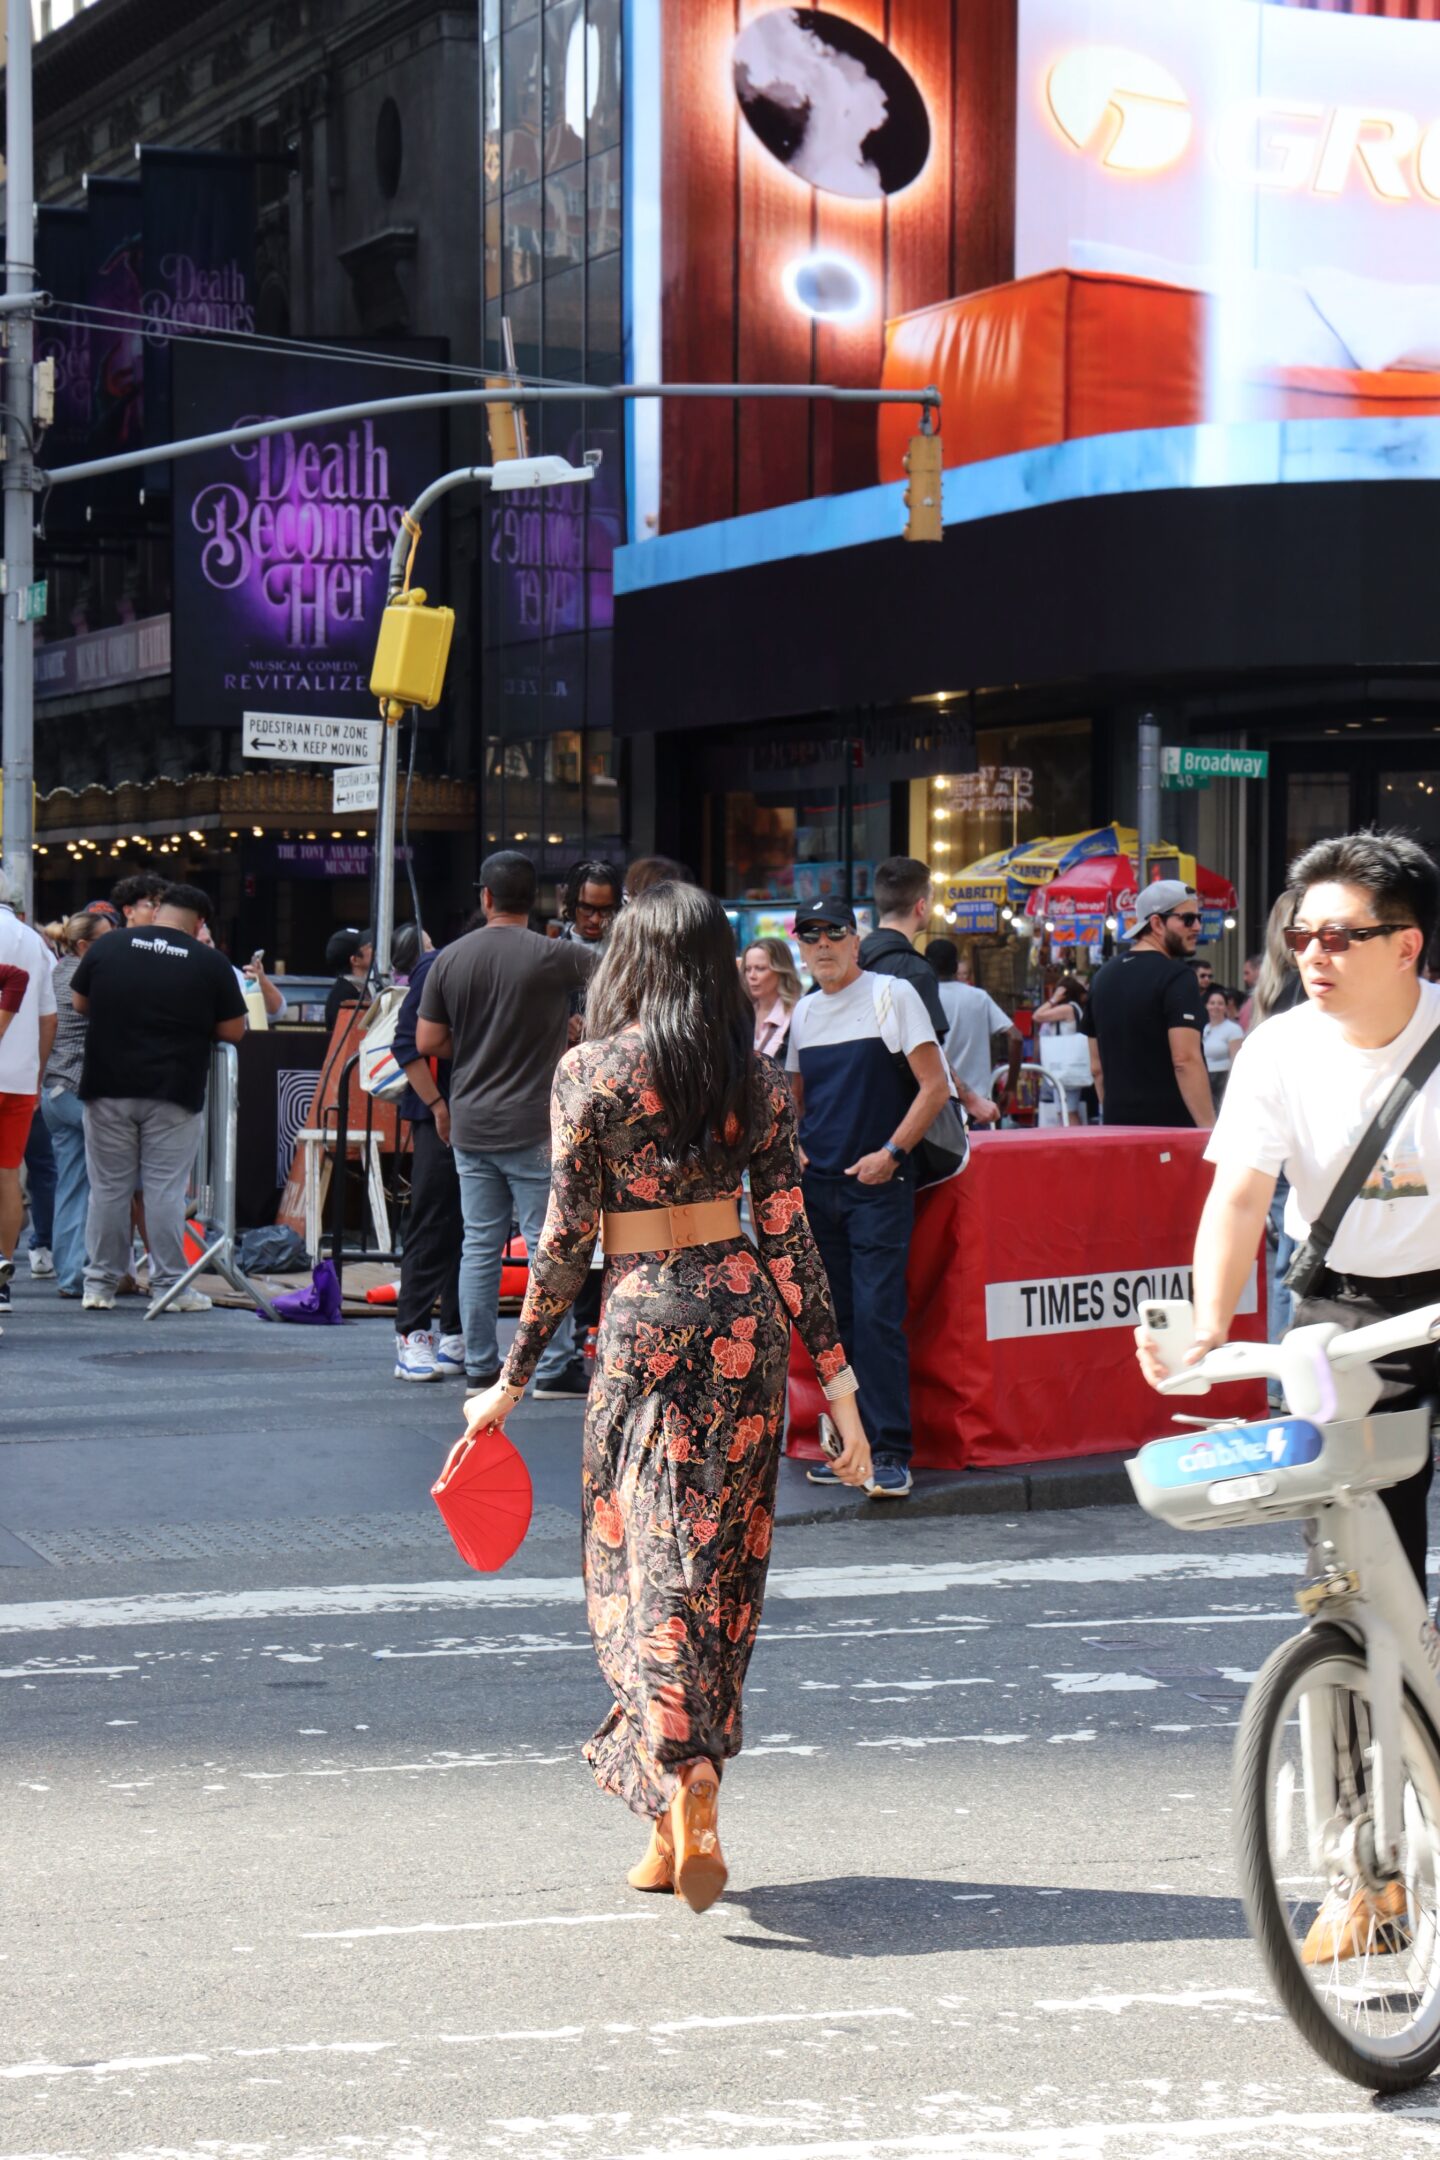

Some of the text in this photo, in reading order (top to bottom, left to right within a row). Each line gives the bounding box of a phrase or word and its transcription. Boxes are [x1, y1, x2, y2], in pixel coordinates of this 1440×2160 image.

[159, 253, 245, 301] Death
[139, 290, 255, 347] Becomes
[230, 414, 390, 501] Death
[191, 483, 405, 589] Becomes
[262, 563, 373, 648] Her
[249, 660, 360, 673] MUSICAL COMEDY
[224, 673, 367, 691] REVITALIZE
[250, 718, 368, 740] PEDESTRIAN FLOW ZONE
[303, 741, 368, 758] KEEP MOVING
[1184, 752, 1263, 778] Broadway
[277, 845, 296, 859] THE
[301, 845, 325, 859] TONY
[324, 860, 367, 874] MUSICAL
[1010, 865, 1054, 878] SABRETT
[950, 885, 1002, 899] SABRETT
[1020, 1280, 1104, 1327] TIMES
